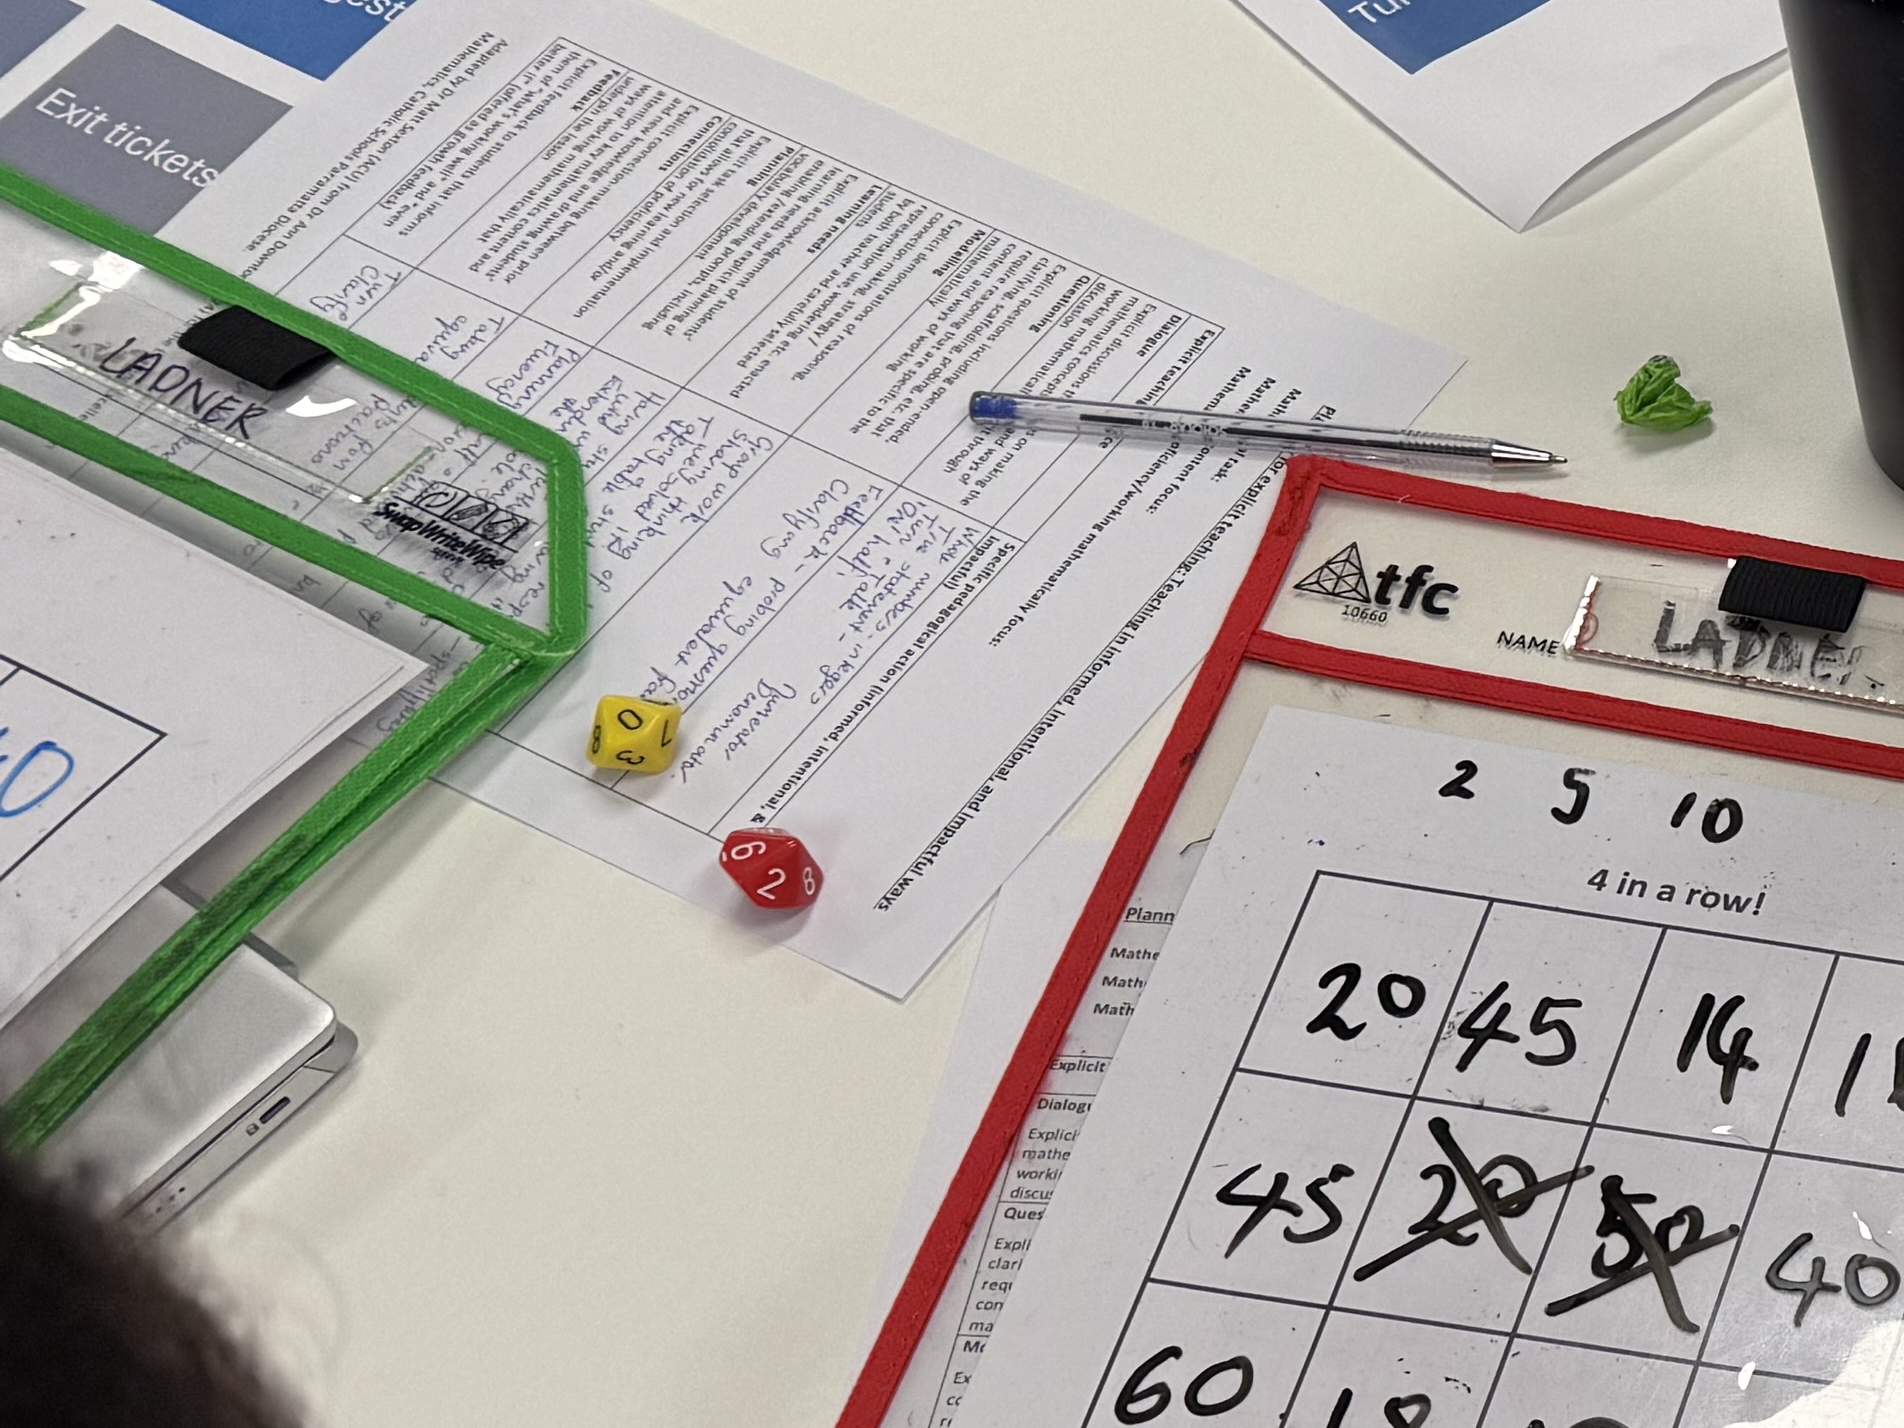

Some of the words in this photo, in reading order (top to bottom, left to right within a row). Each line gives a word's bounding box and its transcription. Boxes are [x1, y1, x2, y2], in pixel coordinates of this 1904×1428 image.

[35, 86, 108, 138] Exit
[103, 113, 220, 189] tickets
[100, 337, 268, 440] LADNER
[1340, 602, 1390, 624] 10660
[1376, 562, 1461, 619] tfc
[1497, 628, 1560, 656] NAME
[969, 783, 994, 812] and
[1438, 759, 1480, 801] 2
[1550, 767, 1596, 825] 5
[1669, 790, 1746, 844] 10
[756, 867, 787, 900] 2
[876, 874, 914, 913] ways
[1586, 867, 1609, 895] 4
[1615, 870, 1652, 899] in
[1655, 881, 1676, 903] a
[1680, 883, 1768, 917] row!
[1303, 961, 1428, 1043] 20
[1455, 980, 1582, 1074] 45
[1676, 992, 1762, 1104] 14
[1214, 1161, 1356, 1261] 45
[1767, 1230, 1903, 1328] 40
[1114, 1345, 1256, 1426] 60
